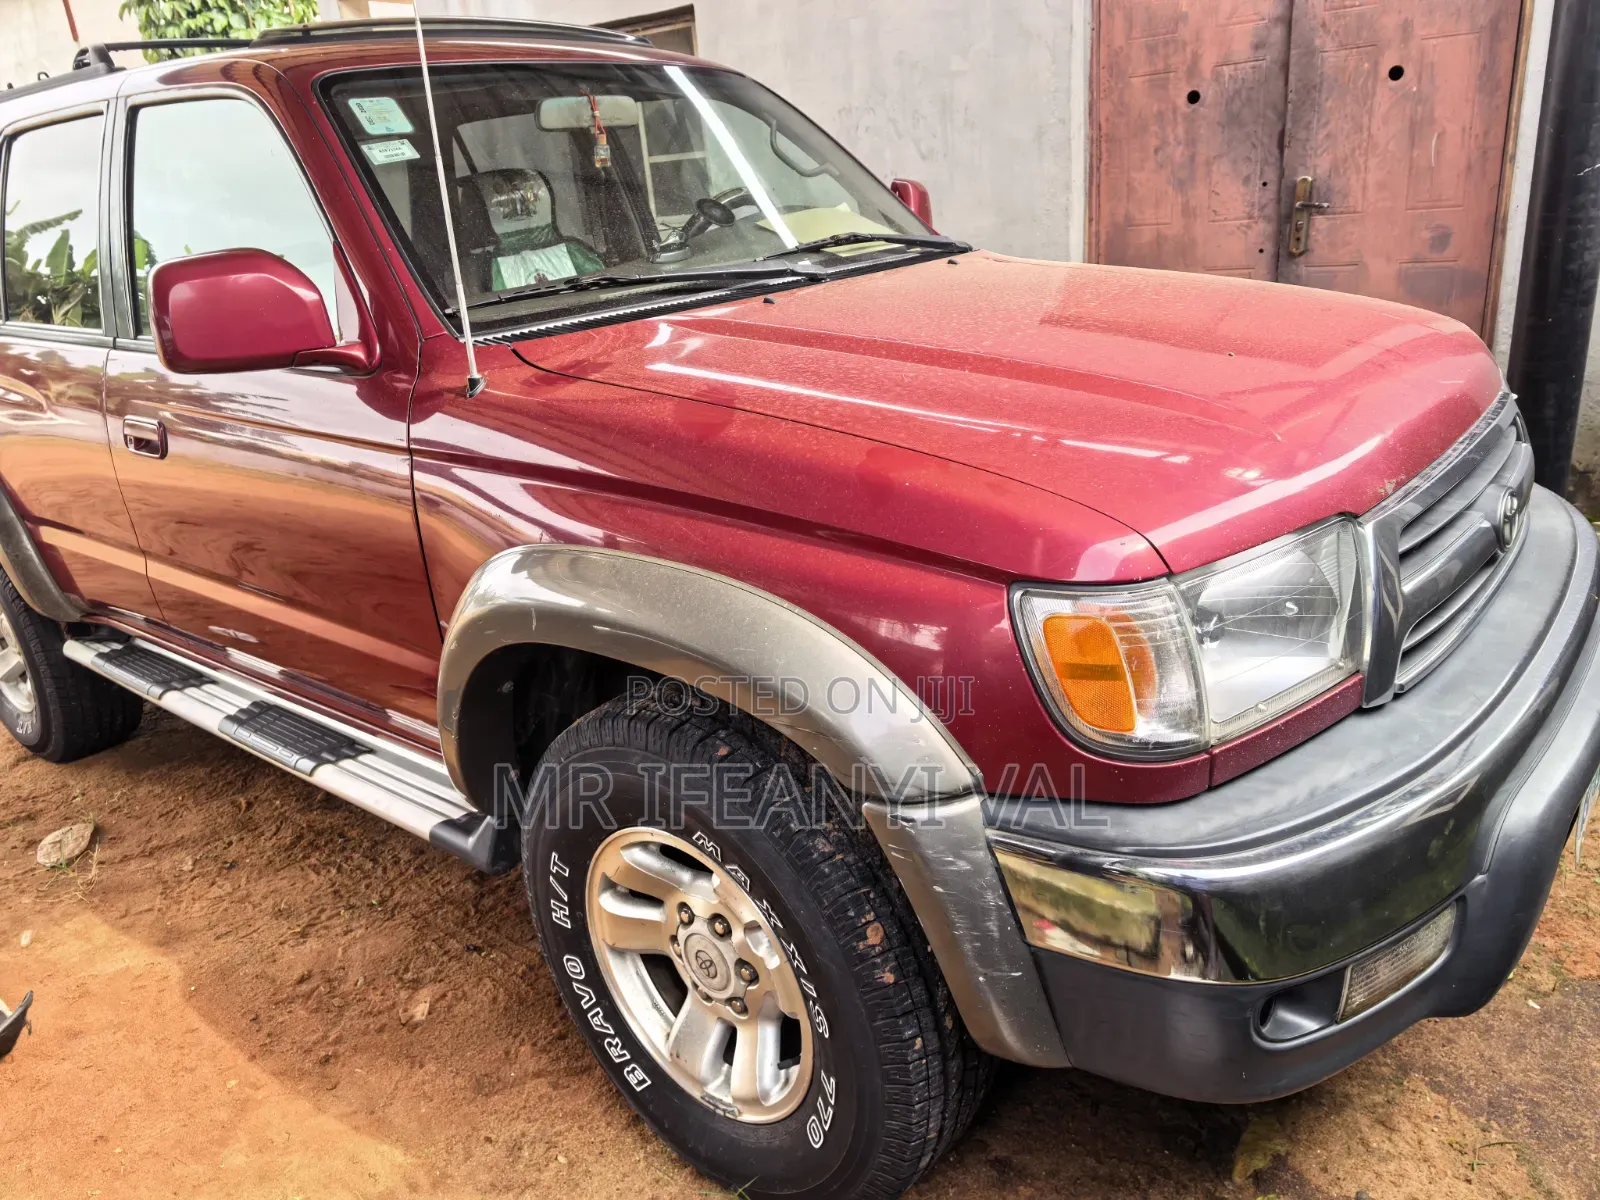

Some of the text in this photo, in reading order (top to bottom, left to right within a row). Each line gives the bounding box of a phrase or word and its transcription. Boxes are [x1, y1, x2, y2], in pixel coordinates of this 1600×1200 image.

[549, 852, 652, 1092] BRAVO H/T
[692, 831, 836, 1149] MAXXIS 770
